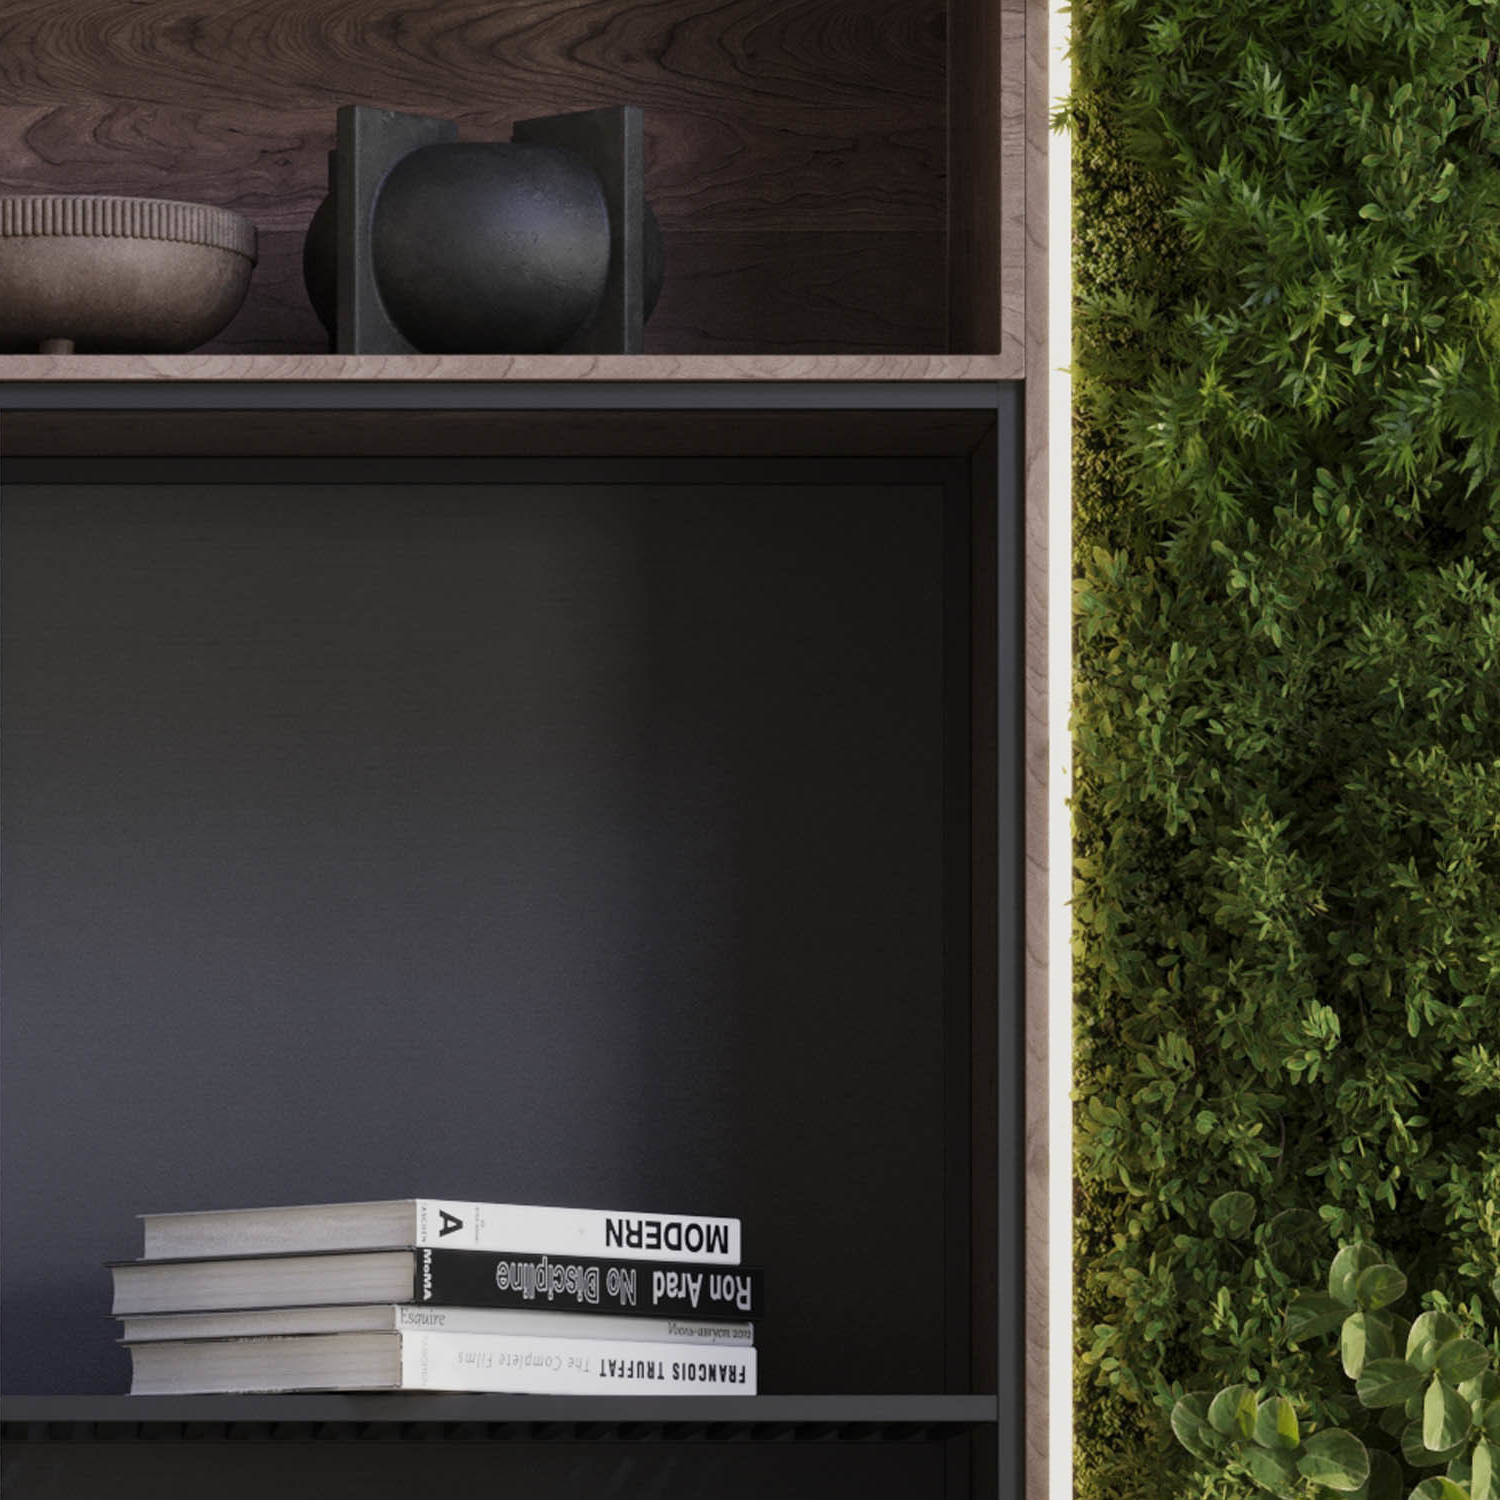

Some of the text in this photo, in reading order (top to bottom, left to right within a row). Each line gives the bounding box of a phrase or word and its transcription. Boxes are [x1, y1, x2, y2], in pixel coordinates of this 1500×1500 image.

[438, 1209, 464, 1238] A
[605, 1218, 729, 1254] MODERN
[423, 1249, 432, 1300] MoMA
[496, 1255, 751, 1311] Ron Arad No Discipline
[401, 1306, 446, 1327] Esquire
[457, 1350, 493, 1369] Films
[500, 1351, 564, 1372] Complete
[566, 1356, 589, 1373] The
[600, 1358, 665, 1380] TRUFFAT
